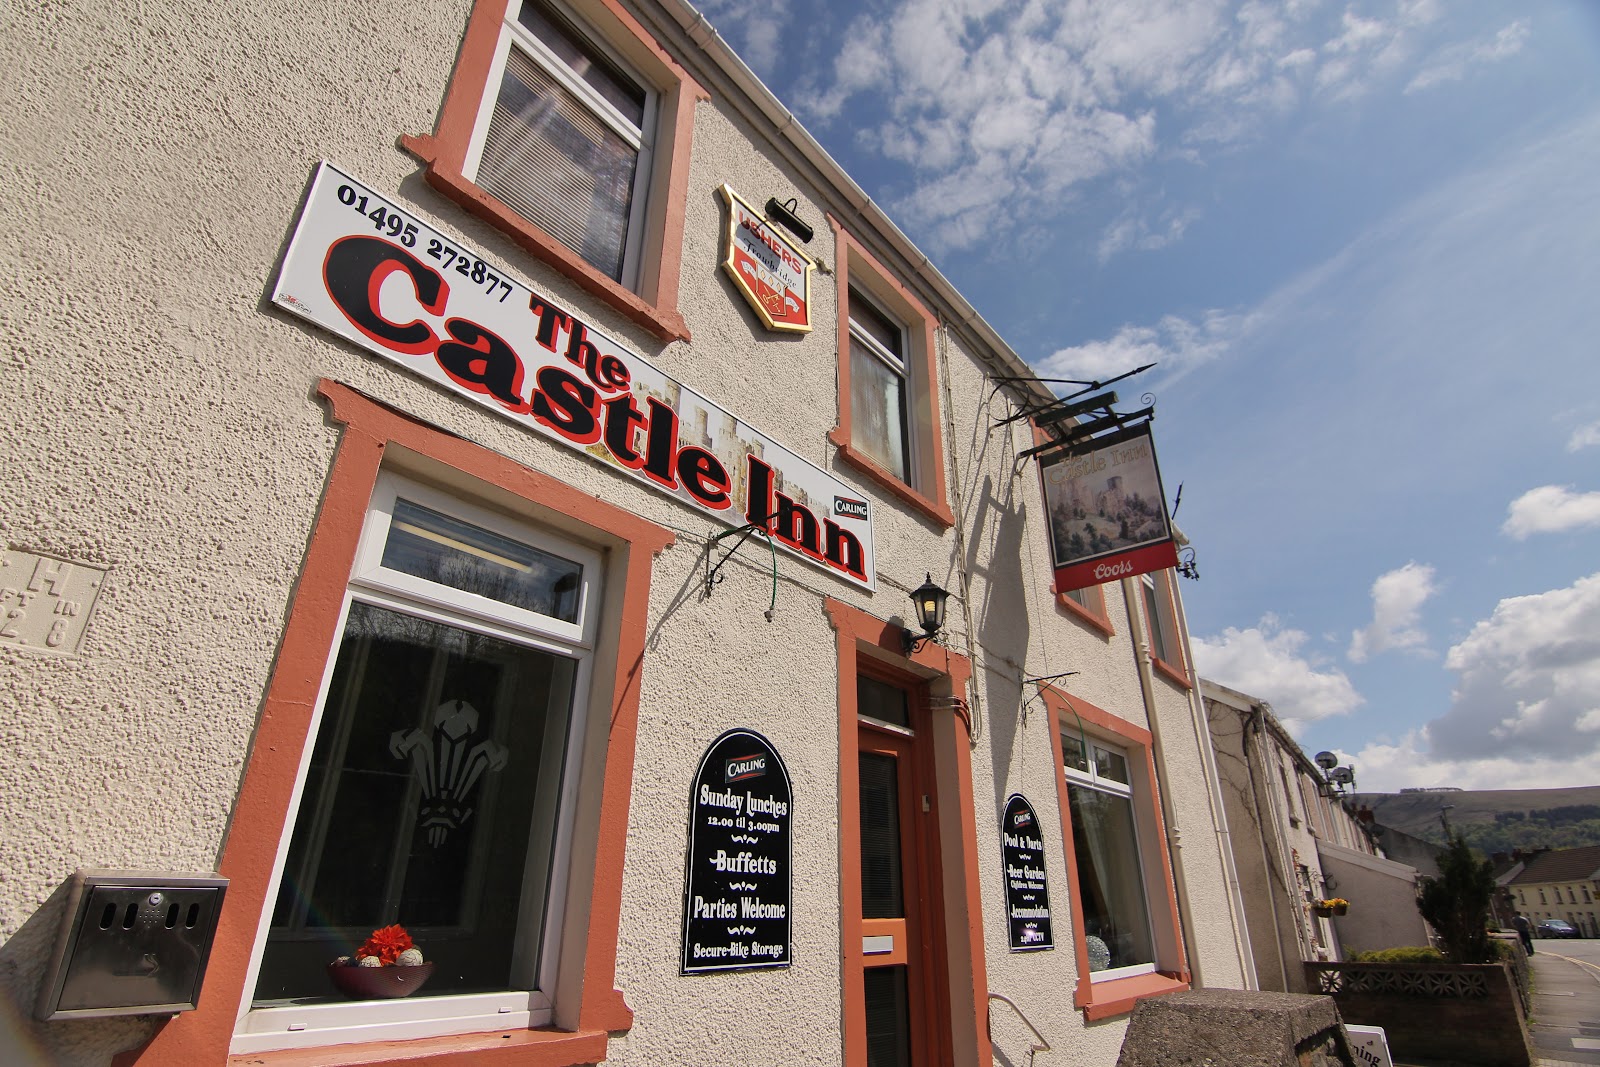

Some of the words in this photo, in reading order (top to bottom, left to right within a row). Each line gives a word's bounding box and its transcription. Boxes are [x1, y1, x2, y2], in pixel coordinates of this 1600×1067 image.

[337, 184, 419, 248] 01495
[427, 238, 513, 303] 272877
[738, 210, 801, 275] USHERS
[743, 237, 797, 288] Trowbridge
[529, 293, 630, 393] The
[322, 234, 732, 511] Castle
[745, 453, 868, 583] Inn
[1049, 450, 1107, 485] Castle
[1111, 442, 1148, 467] Inn
[834, 500, 867, 517] CARLING
[27, 557, 73, 596] H
[1093, 559, 1134, 580] Coors
[45, 618, 69, 648] 8
[727, 758, 765, 777] CARLING
[701, 784, 744, 815] Sunday
[746, 791, 787, 818] Lunches
[707, 816, 734, 827] 12.00
[735, 817, 746, 828] til
[748, 820, 780, 833] 3.00pm
[1014, 814, 1031, 825] CARLING
[1004, 832, 1019, 848] Pool
[1019, 837, 1026, 848] &
[1027, 836, 1042, 850] Darts
[709, 850, 777, 875] Buffetts
[1007, 864, 1023, 878] Beer
[1024, 865, 1045, 880] Garden
[1010, 880, 1028, 890] Children
[1027, 881, 1044, 890] Welcome
[694, 896, 737, 919] Parties
[741, 897, 786, 919] Welcome
[1011, 904, 1049, 918] Accommodation
[751, 942, 784, 957] Storage
